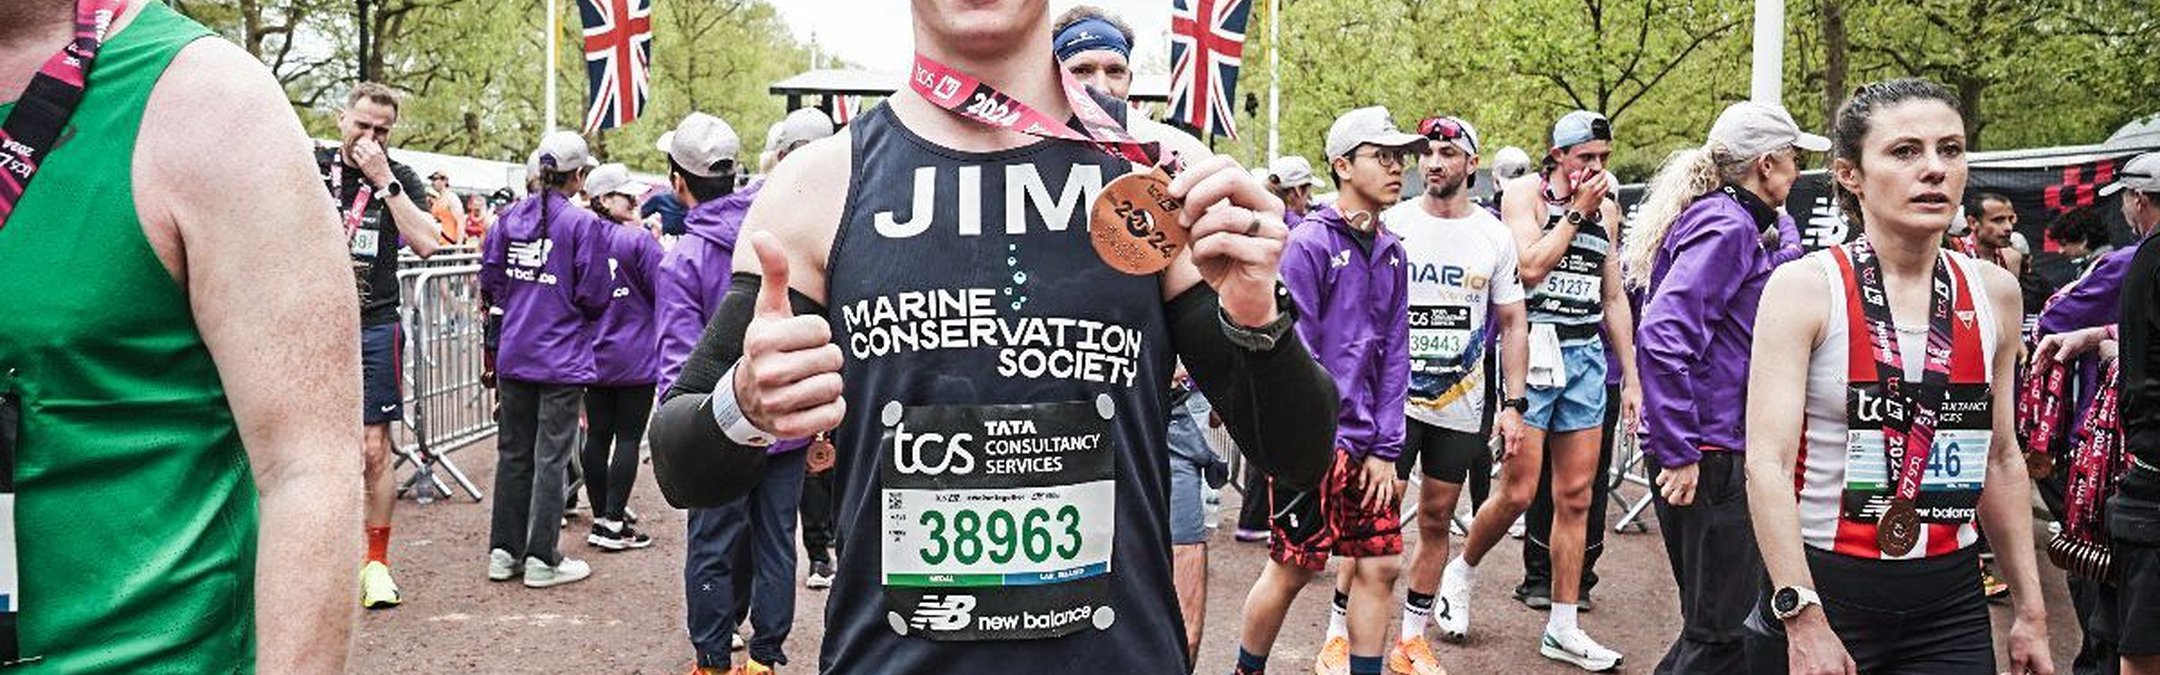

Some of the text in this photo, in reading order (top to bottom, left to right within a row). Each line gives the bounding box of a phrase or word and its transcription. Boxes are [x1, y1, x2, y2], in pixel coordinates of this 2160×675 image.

[874, 163, 1102, 238] JIM
[1547, 276, 1592, 296] 51237
[842, 288, 996, 333] MARINE
[850, 317, 1142, 359] CONSERVATION
[1411, 335, 1460, 352] 39443
[997, 349, 1138, 387] SOCIETY
[984, 420, 1037, 435] TATA
[985, 433, 1101, 455] CONSULTANCY
[894, 422, 974, 475] tcs
[985, 456, 1063, 474] SERVICES
[1888, 436, 1904, 482] 2024
[919, 504, 1083, 565] 38963
[978, 605, 1092, 631] new balance
